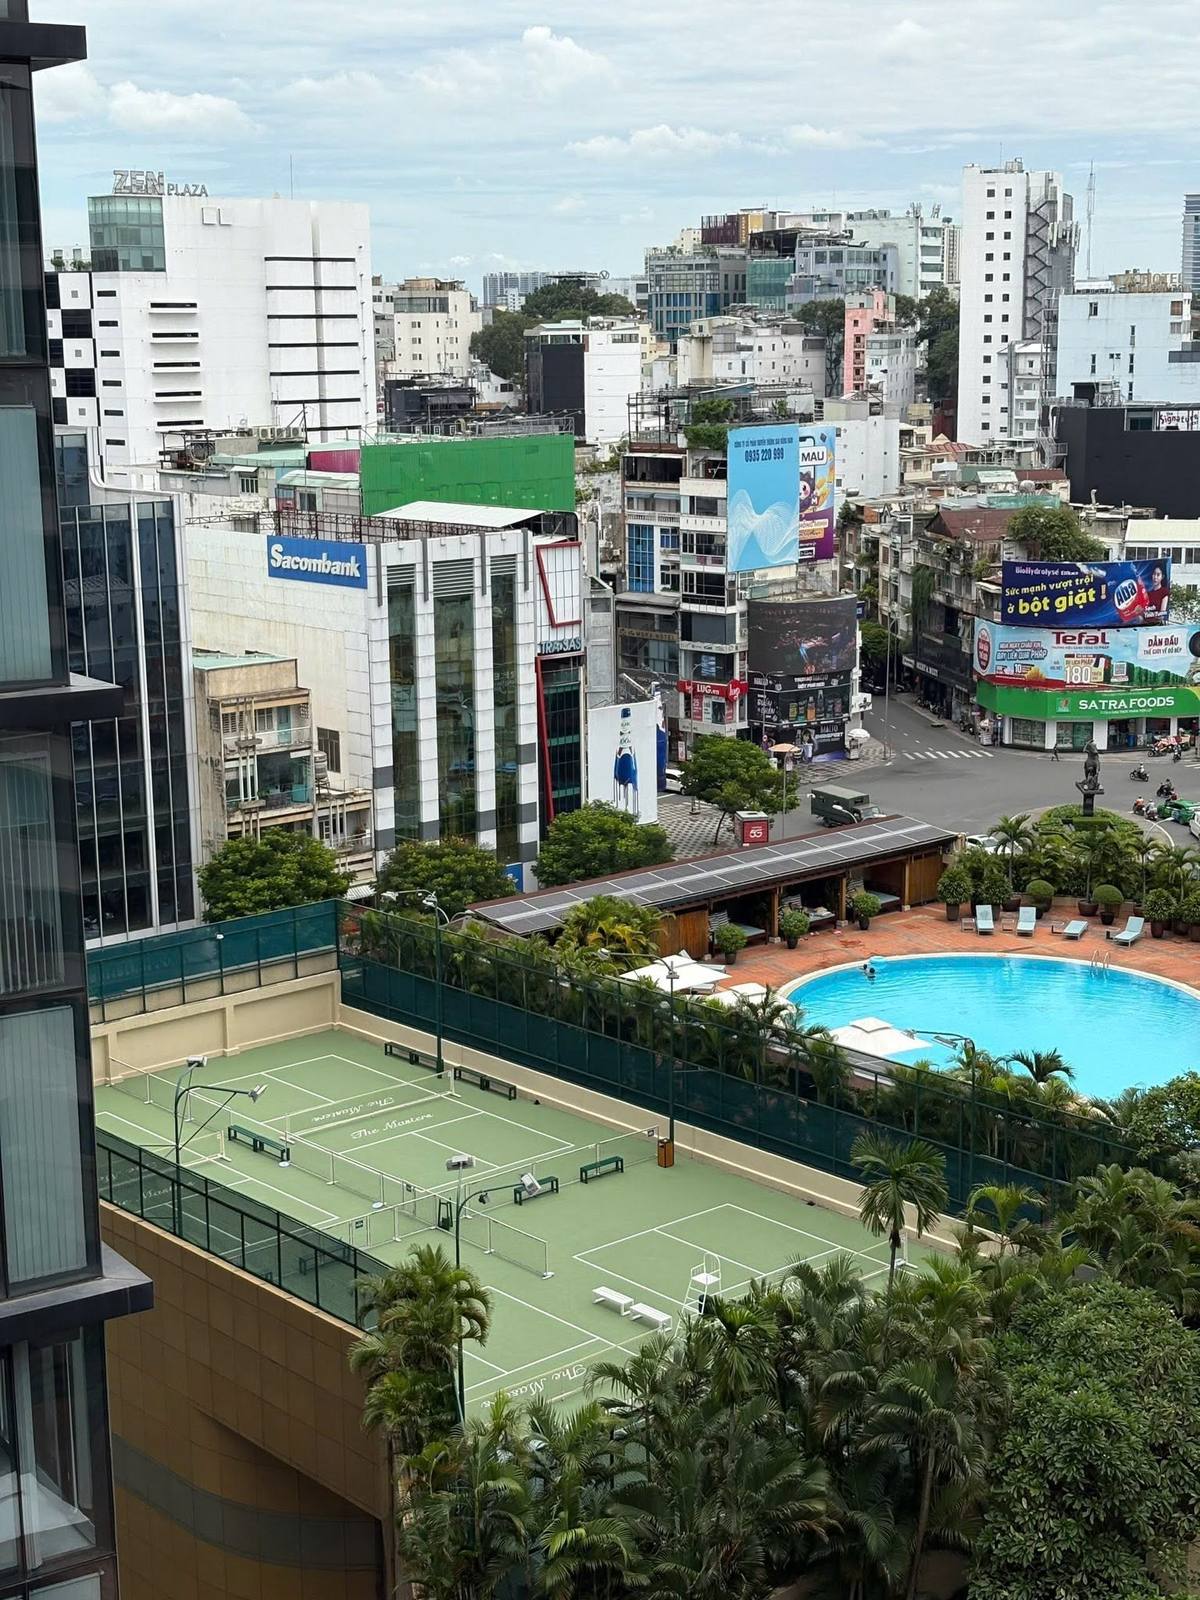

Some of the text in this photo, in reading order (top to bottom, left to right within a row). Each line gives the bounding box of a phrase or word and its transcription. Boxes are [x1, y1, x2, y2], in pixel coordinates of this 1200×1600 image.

[113, 169, 208, 197] ZEN PLAZA
[761, 448, 772, 461] 220
[801, 451, 825, 463] MAU
[270, 543, 361, 578] Sacombank
[1005, 587, 1020, 597] Sức
[1021, 583, 1047, 596] mạnh
[1049, 579, 1073, 590] vượt
[1075, 573, 1094, 586] trội
[1116, 582, 1137, 606] Aba
[1007, 603, 1015, 614] ở
[1018, 596, 1050, 617] bột
[1054, 588, 1096, 613] giặt
[1052, 632, 1110, 645] Tefal
[1065, 666, 1091, 684] 180
[311, 1097, 395, 1123] The Masters
[350, 1112, 433, 1140] The Masters
[551, 1364, 588, 1381] The
